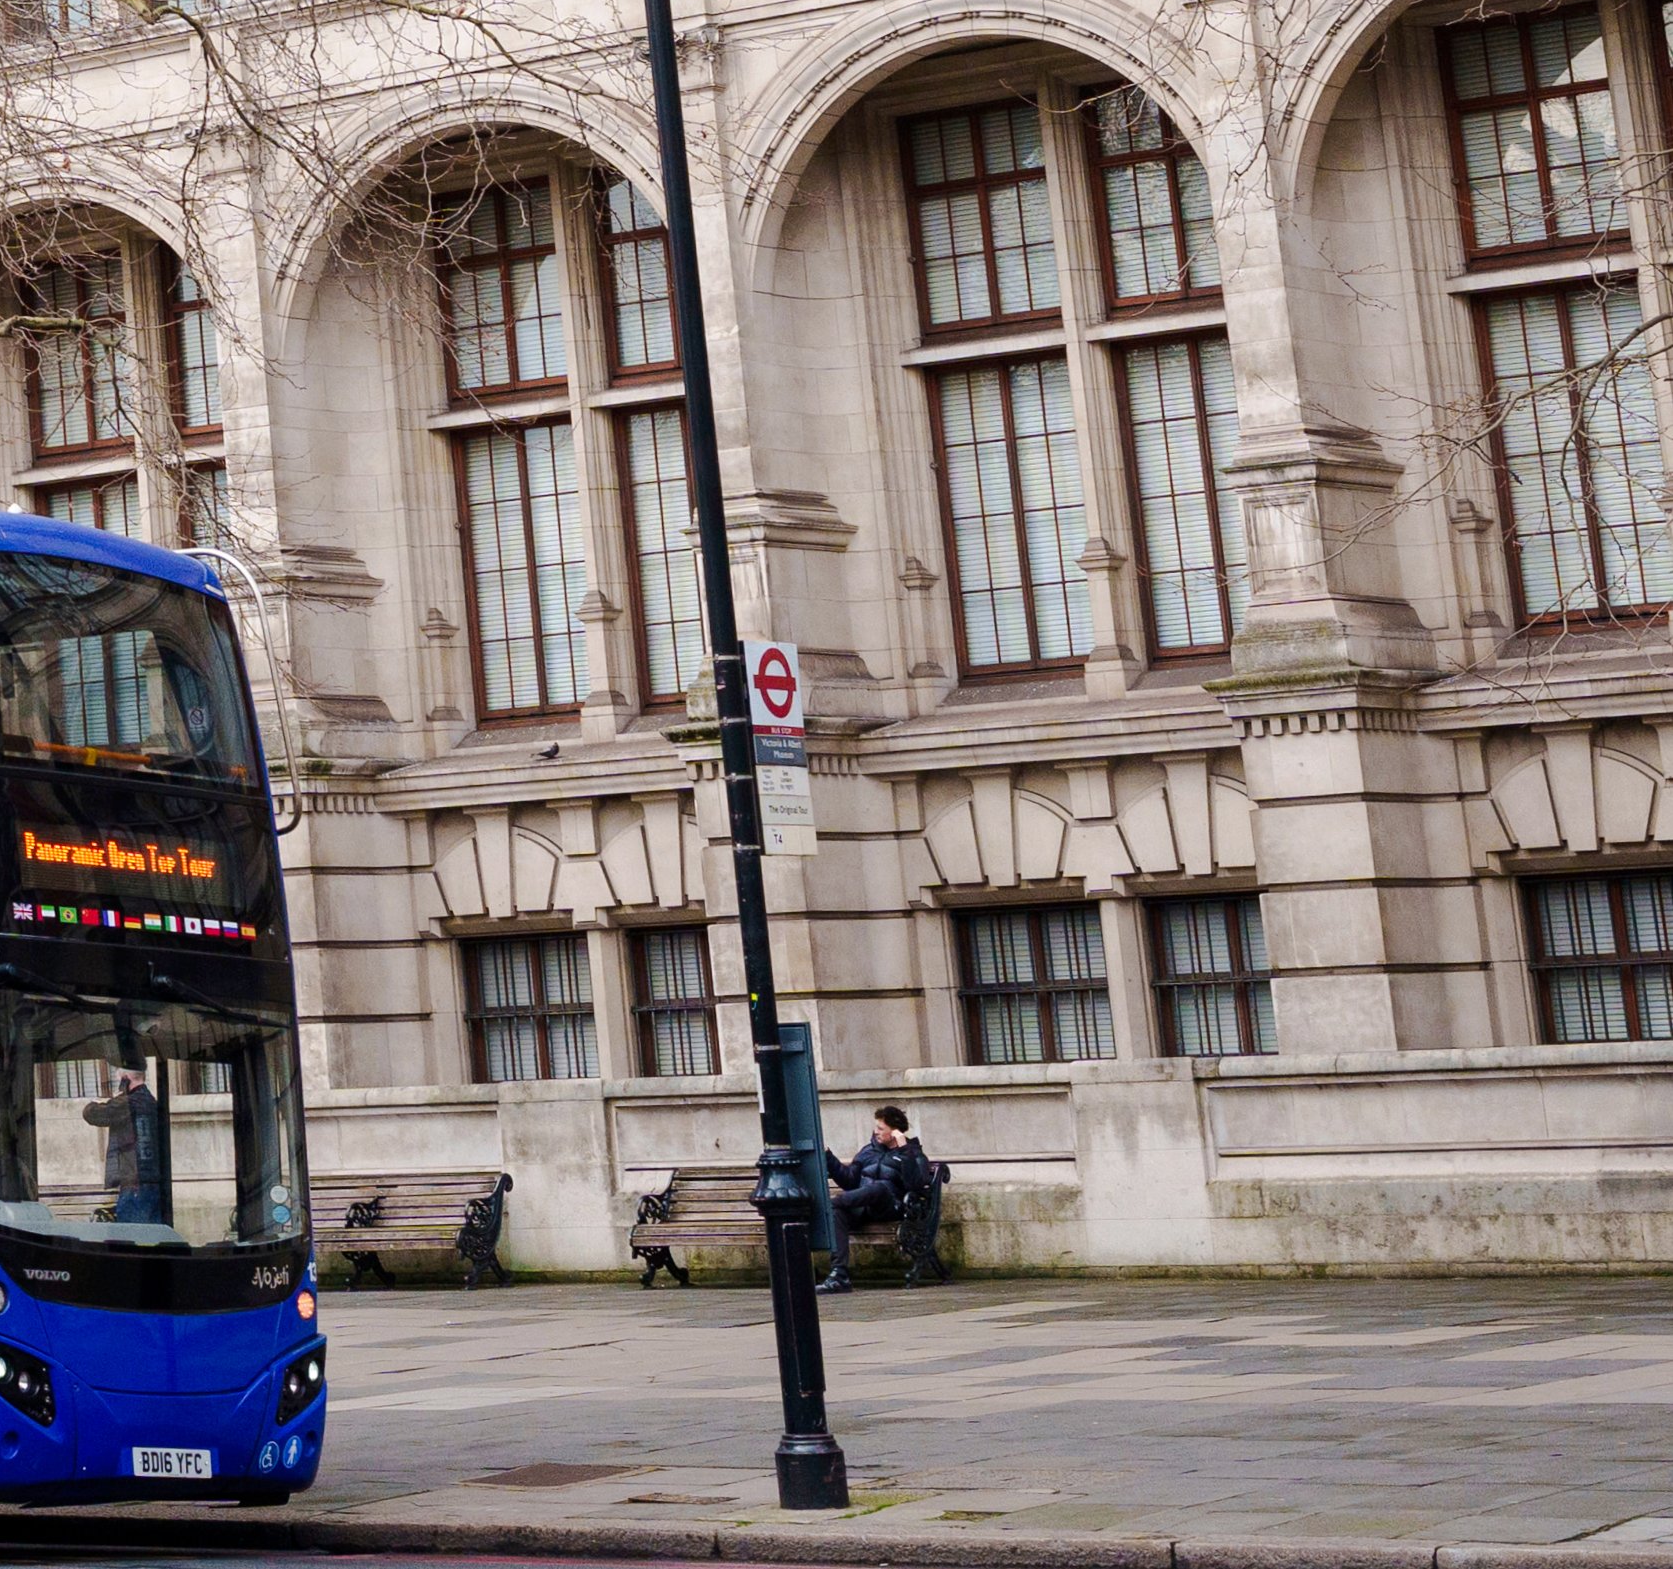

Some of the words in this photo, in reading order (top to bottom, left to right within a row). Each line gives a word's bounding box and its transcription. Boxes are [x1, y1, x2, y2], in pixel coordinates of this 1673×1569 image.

[773, 833, 783, 845] T4
[24, 831, 107, 867] Panoramic
[146, 844, 176, 874] Top
[177, 848, 216, 878] Tour
[23, 1268, 71, 1281] VOLVO
[141, 1451, 172, 1473] BD16
[176, 1452, 203, 1474] YFC
